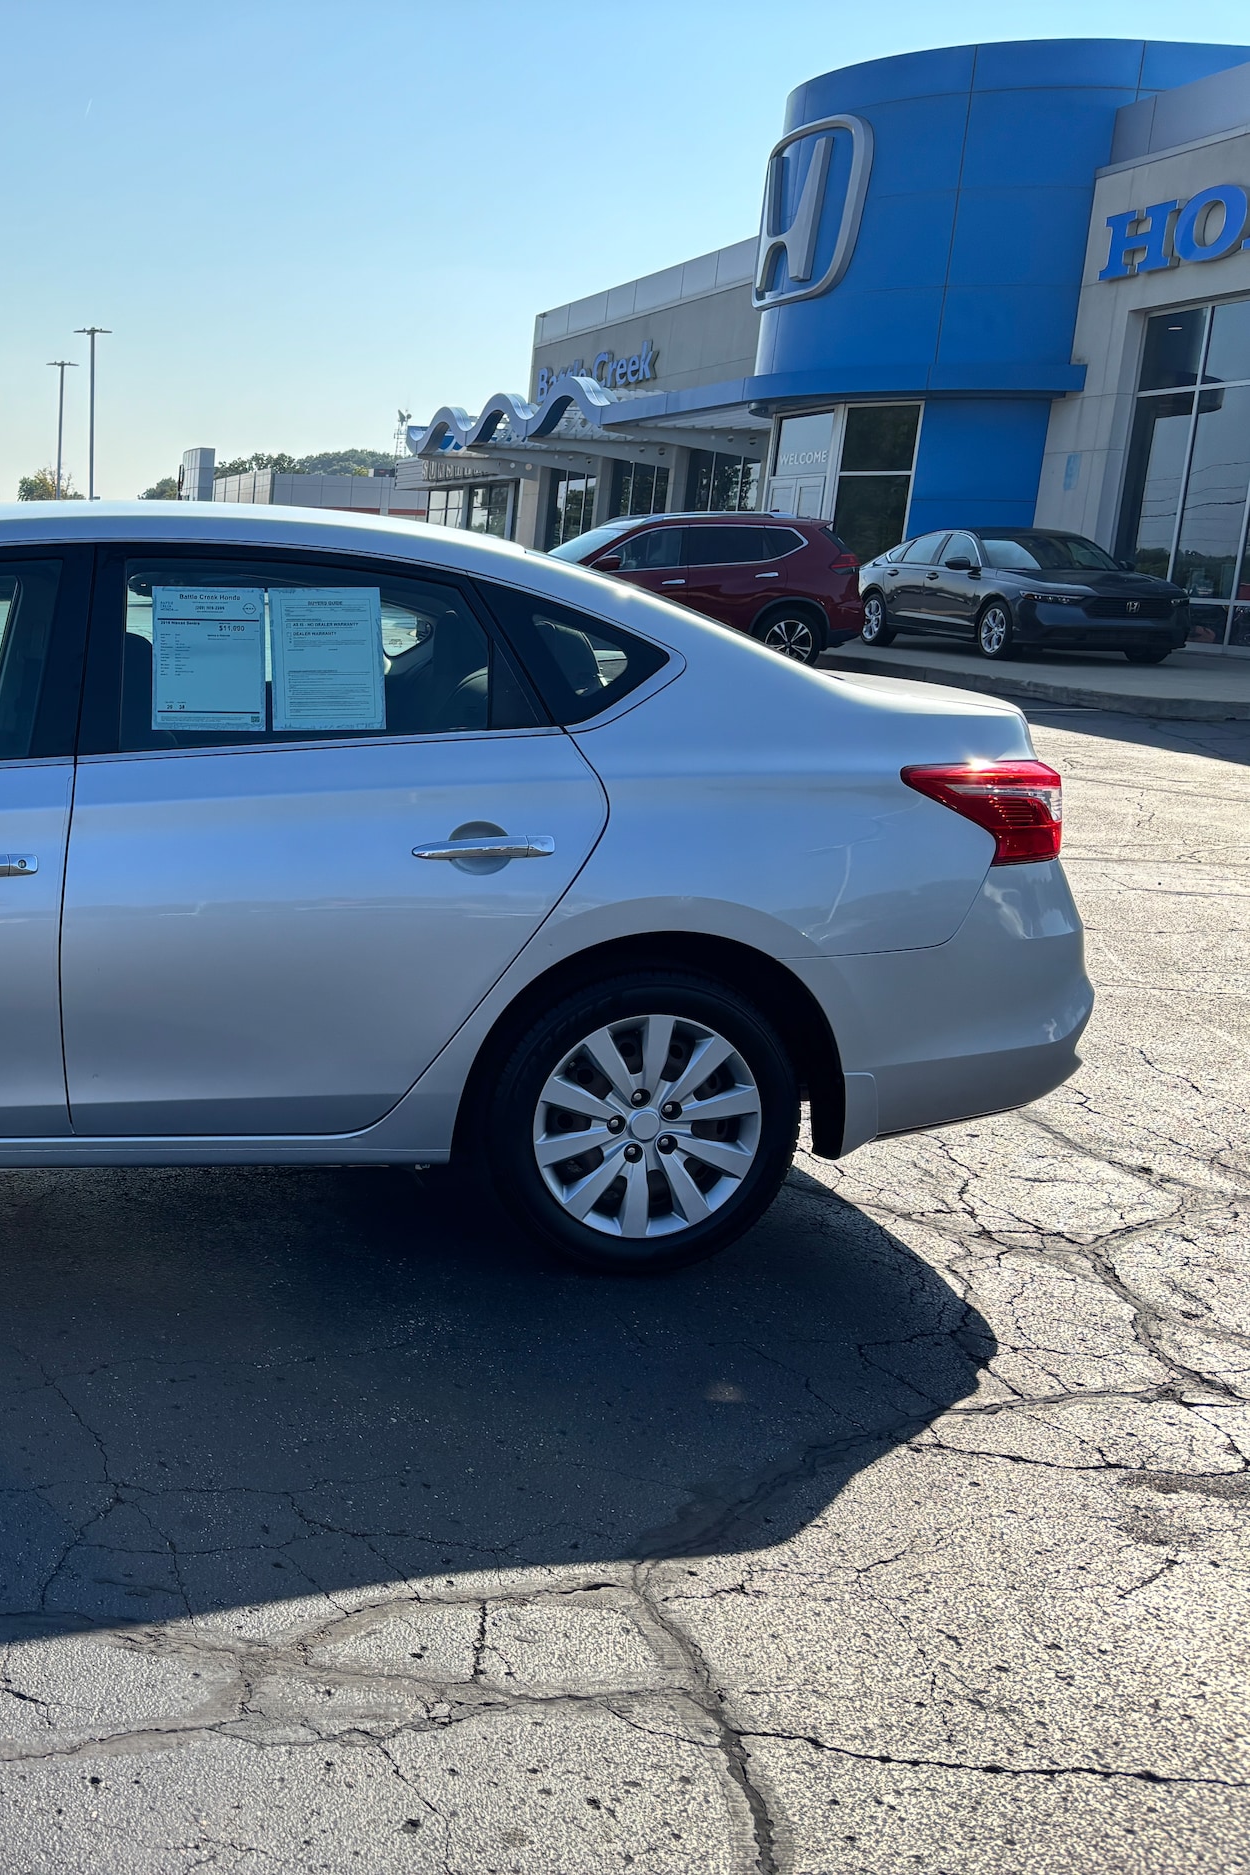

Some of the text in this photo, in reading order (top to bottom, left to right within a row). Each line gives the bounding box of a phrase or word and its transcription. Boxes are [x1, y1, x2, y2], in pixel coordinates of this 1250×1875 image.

[1099, 184, 1250, 281] HO
[592, 340, 653, 388] Creek
[779, 450, 828, 465] WELCOME
